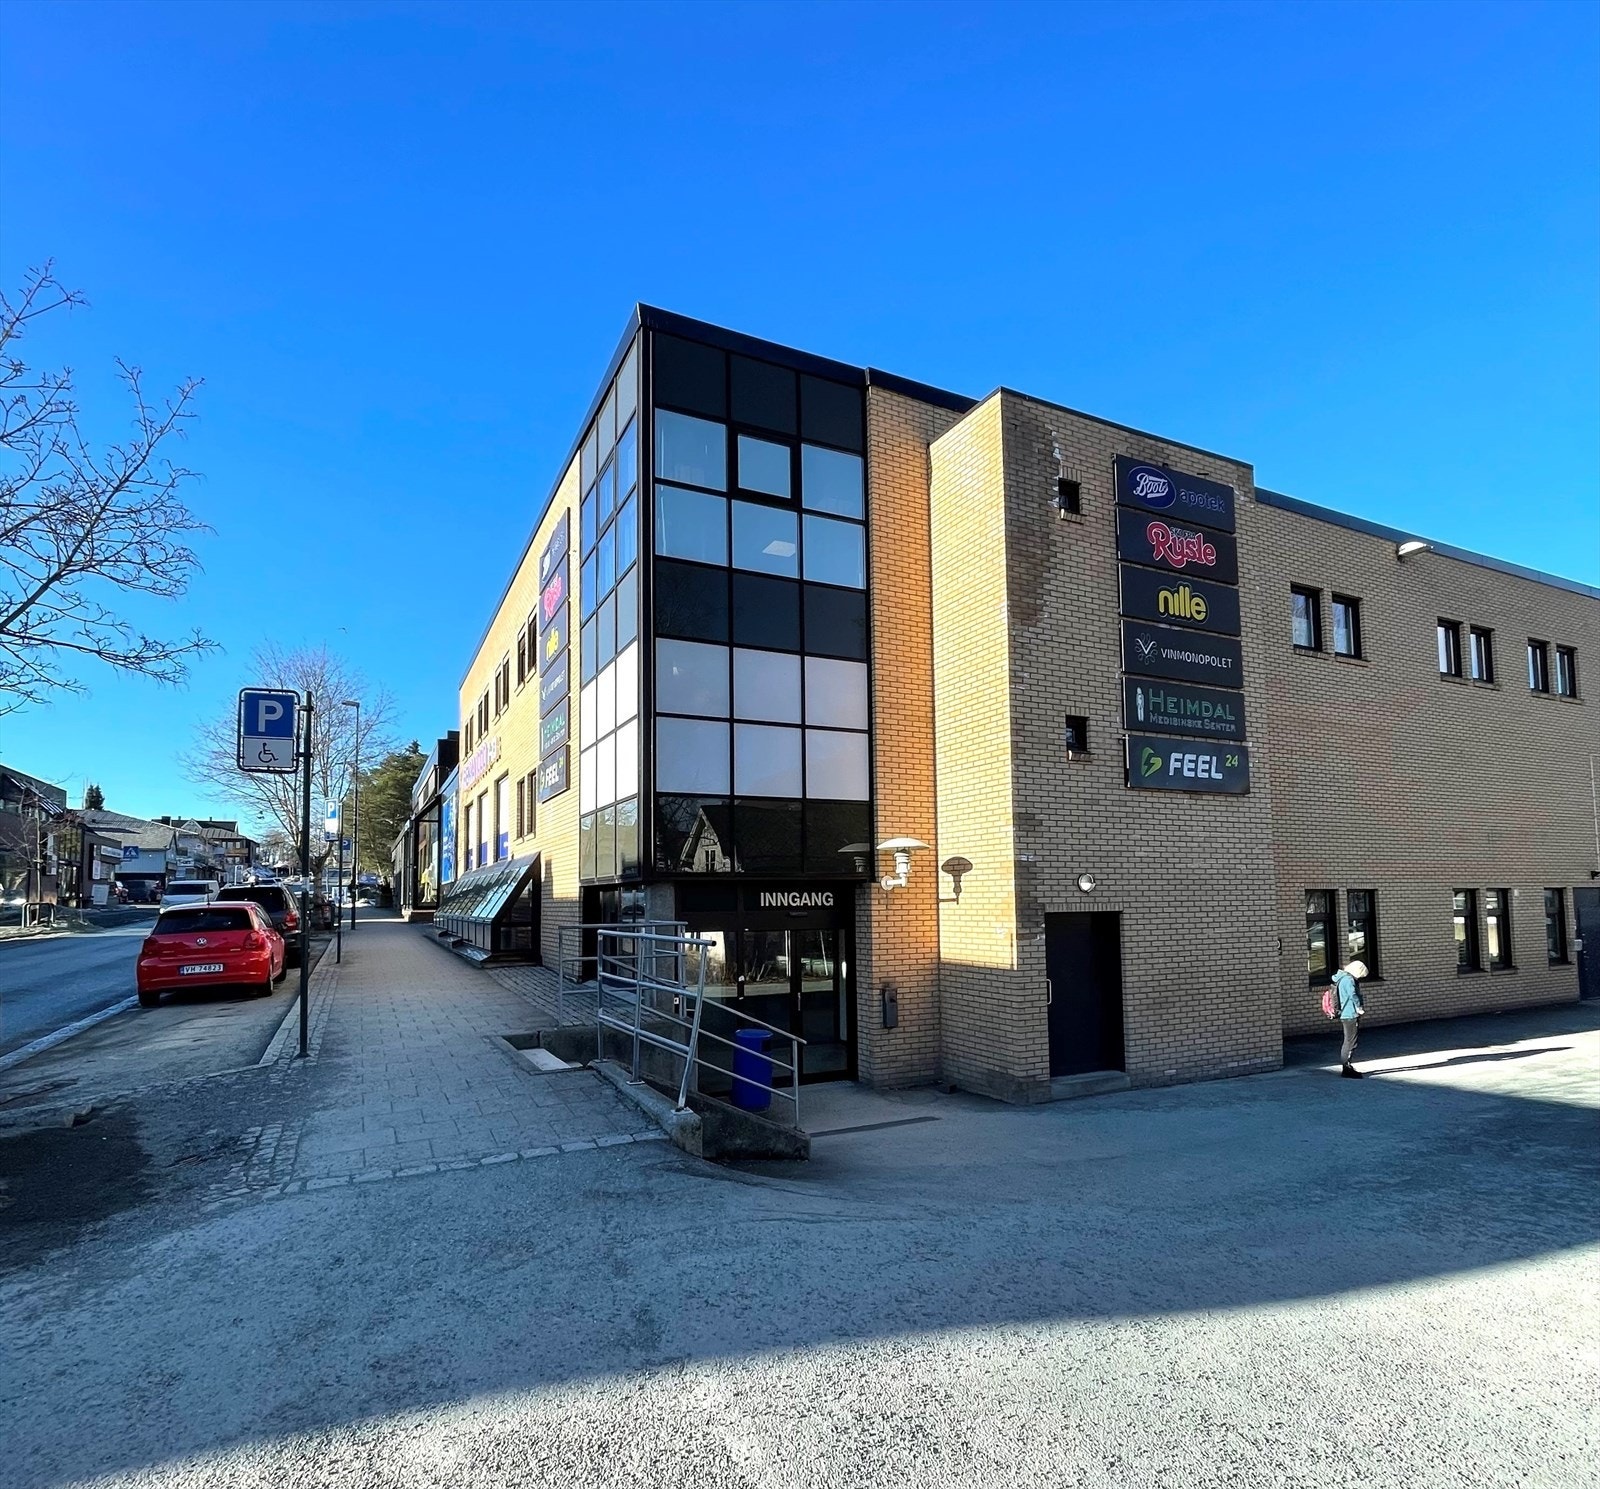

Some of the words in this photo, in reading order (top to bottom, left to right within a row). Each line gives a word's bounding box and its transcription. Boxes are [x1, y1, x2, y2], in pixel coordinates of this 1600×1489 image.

[1133, 472, 1169, 499] Boots
[1179, 488, 1226, 513] apotek
[1146, 521, 1217, 568] Rusle
[1158, 585, 1207, 621] nille
[1160, 648, 1233, 669] VINMONOPOLET
[258, 700, 284, 733] P
[1149, 688, 1236, 721] HEIMDAL
[1204, 718, 1236, 733] SENTER
[1169, 752, 1223, 780] FEEL
[1225, 754, 1239, 768] 24
[327, 802, 336, 818] P
[760, 891, 834, 907] INNGANG
